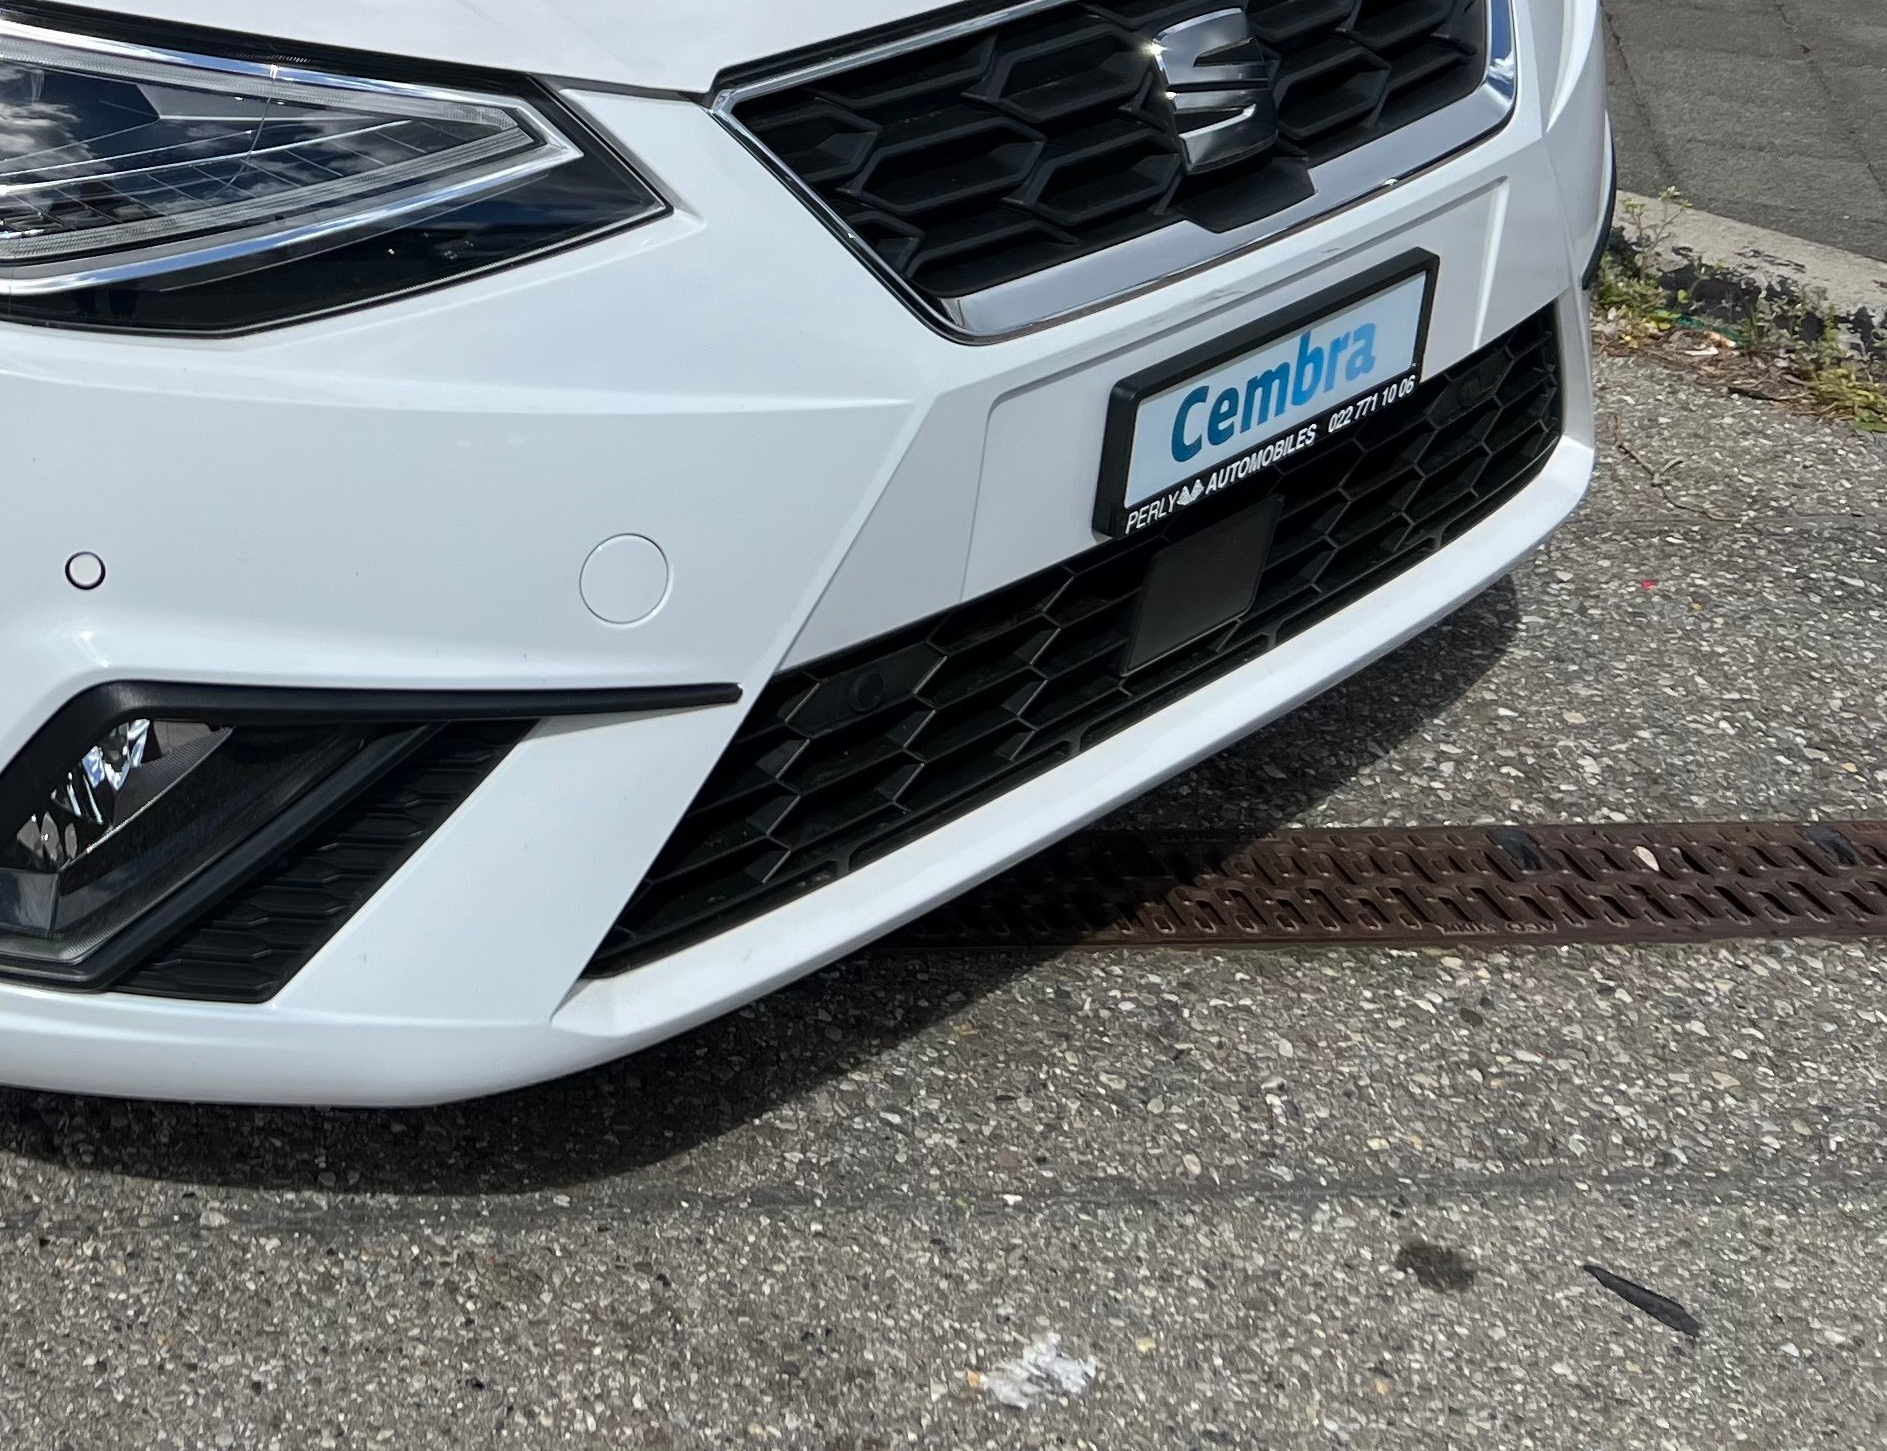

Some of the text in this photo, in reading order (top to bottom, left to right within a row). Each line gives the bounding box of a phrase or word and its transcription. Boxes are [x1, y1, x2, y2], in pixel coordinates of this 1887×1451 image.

[1125, 374, 1416, 534] PERLY AUTOMOBILES 022 771 10 06
[1170, 322, 1376, 463] Cembra
